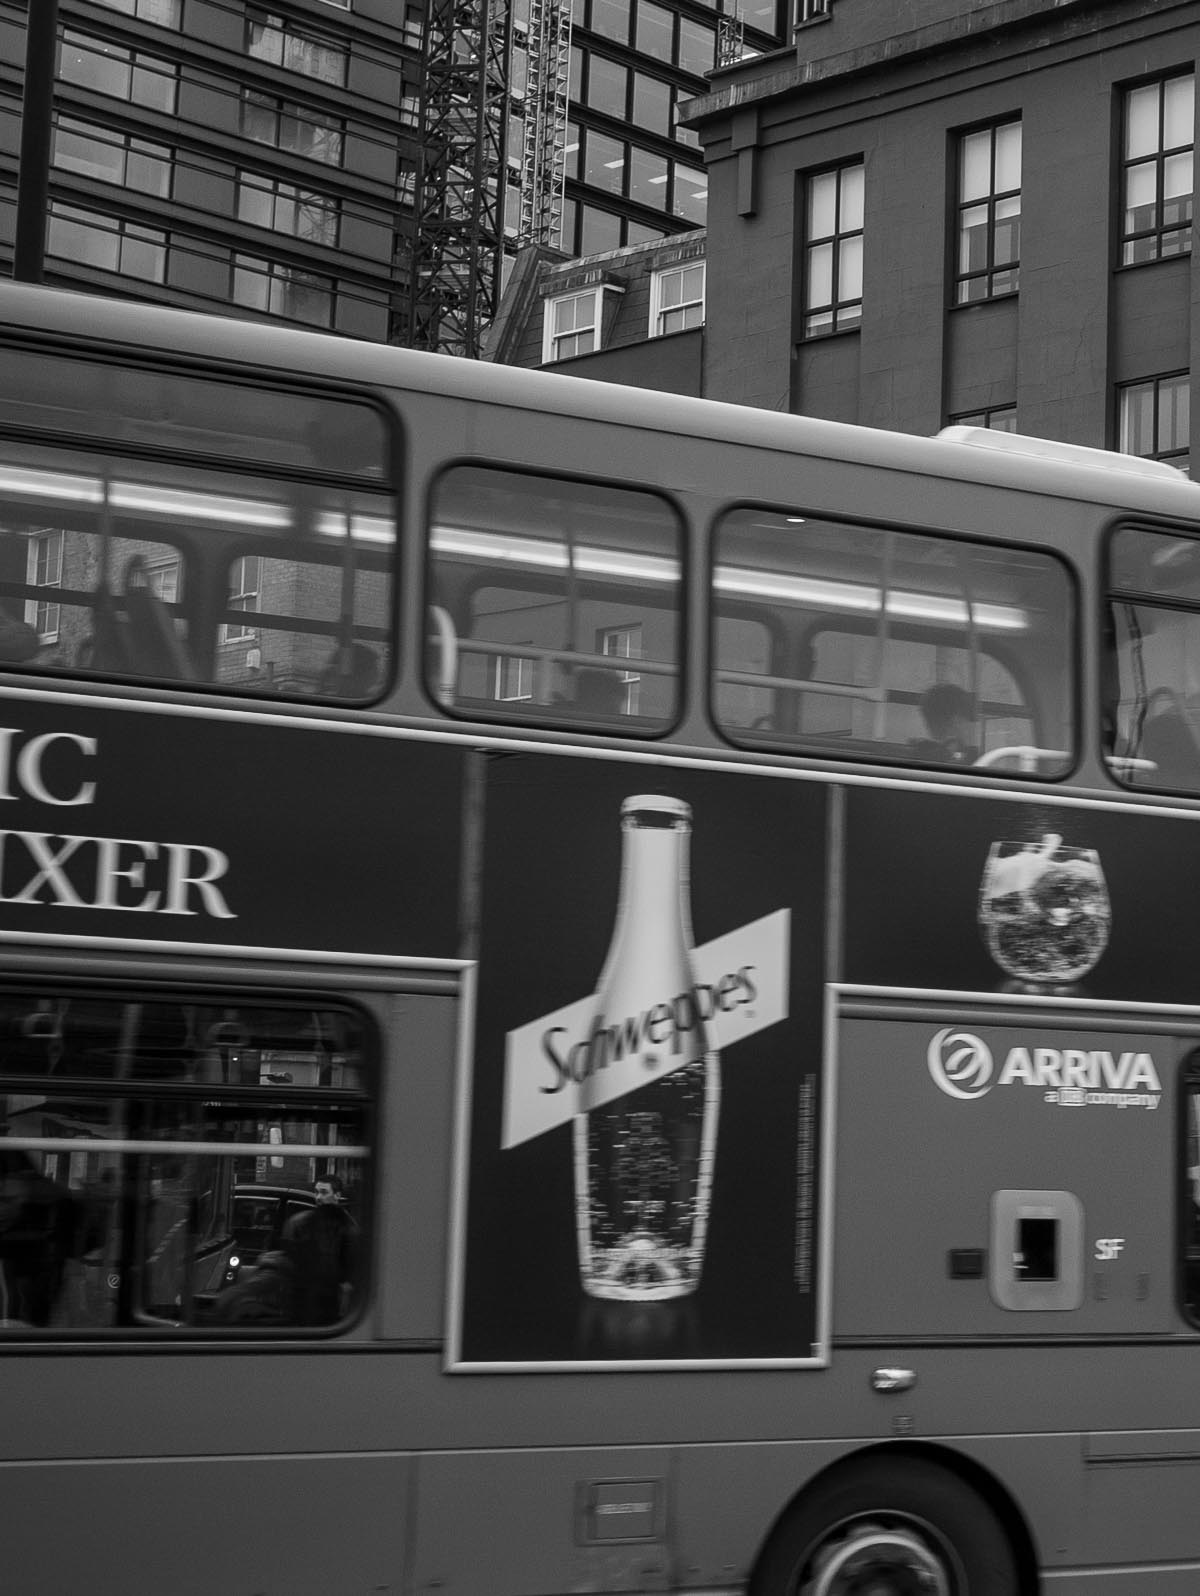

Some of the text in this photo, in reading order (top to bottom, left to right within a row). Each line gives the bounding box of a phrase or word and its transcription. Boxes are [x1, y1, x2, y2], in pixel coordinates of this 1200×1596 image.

[0, 829, 239, 919] XER
[537, 965, 758, 1094] Schweppes
[997, 1047, 1162, 1091] ARRIVA
[1094, 1238, 1125, 1260] SF
